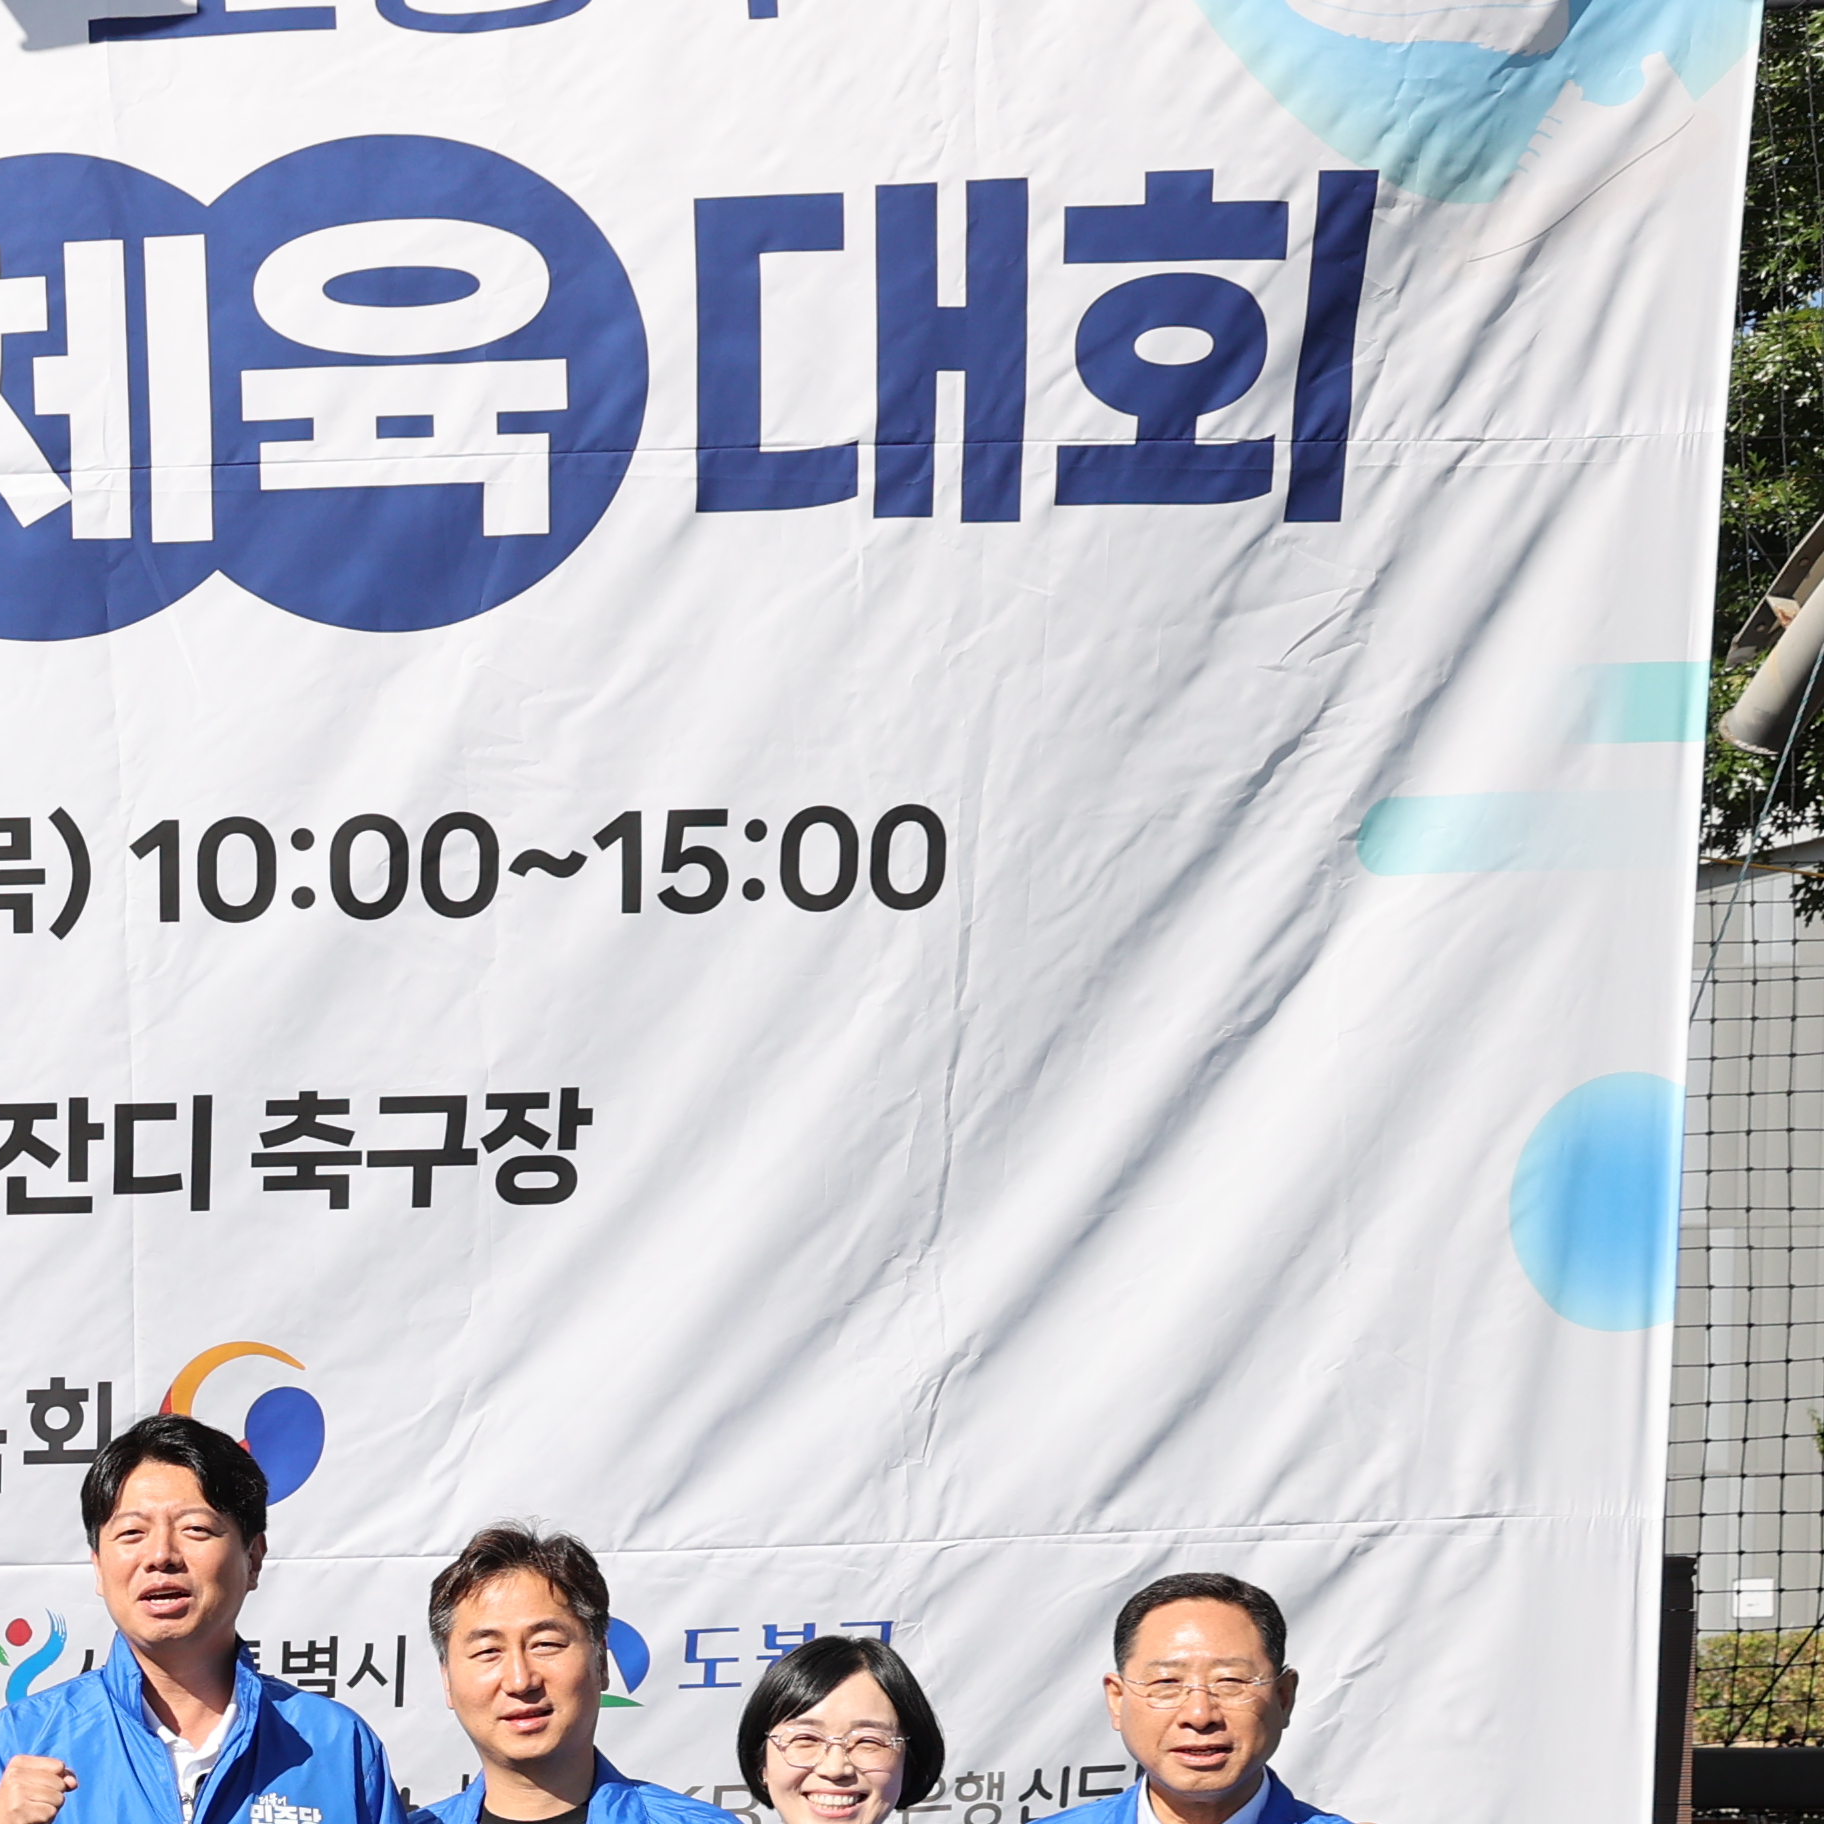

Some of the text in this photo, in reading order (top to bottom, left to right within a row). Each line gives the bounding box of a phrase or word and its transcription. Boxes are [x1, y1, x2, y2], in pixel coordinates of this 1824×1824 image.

[692, 168, 1379, 523] 대회
[129, 804, 947, 926] 10:00~15:00
[249, 1086, 594, 1209] 축구장
